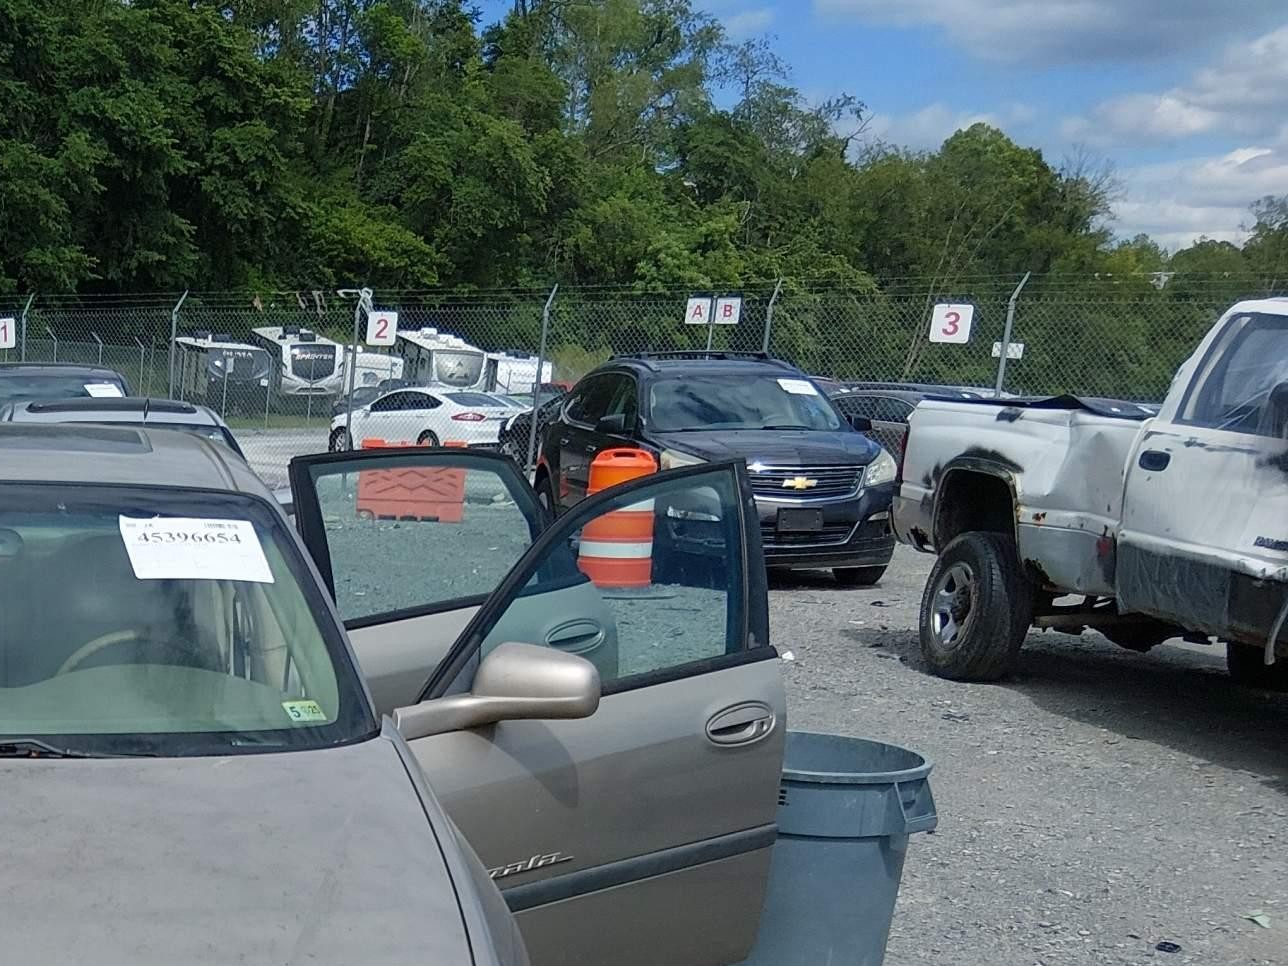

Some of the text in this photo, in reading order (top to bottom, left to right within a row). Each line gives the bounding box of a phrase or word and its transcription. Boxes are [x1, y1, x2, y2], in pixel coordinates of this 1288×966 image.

[691, 304, 703, 318] A
[722, 304, 733, 318] B
[375, 319, 389, 339] 2
[941, 312, 961, 336] 3
[0, 324, 8, 342] 1
[137, 531, 241, 544] 45396654
[289, 706, 301, 718] 5
